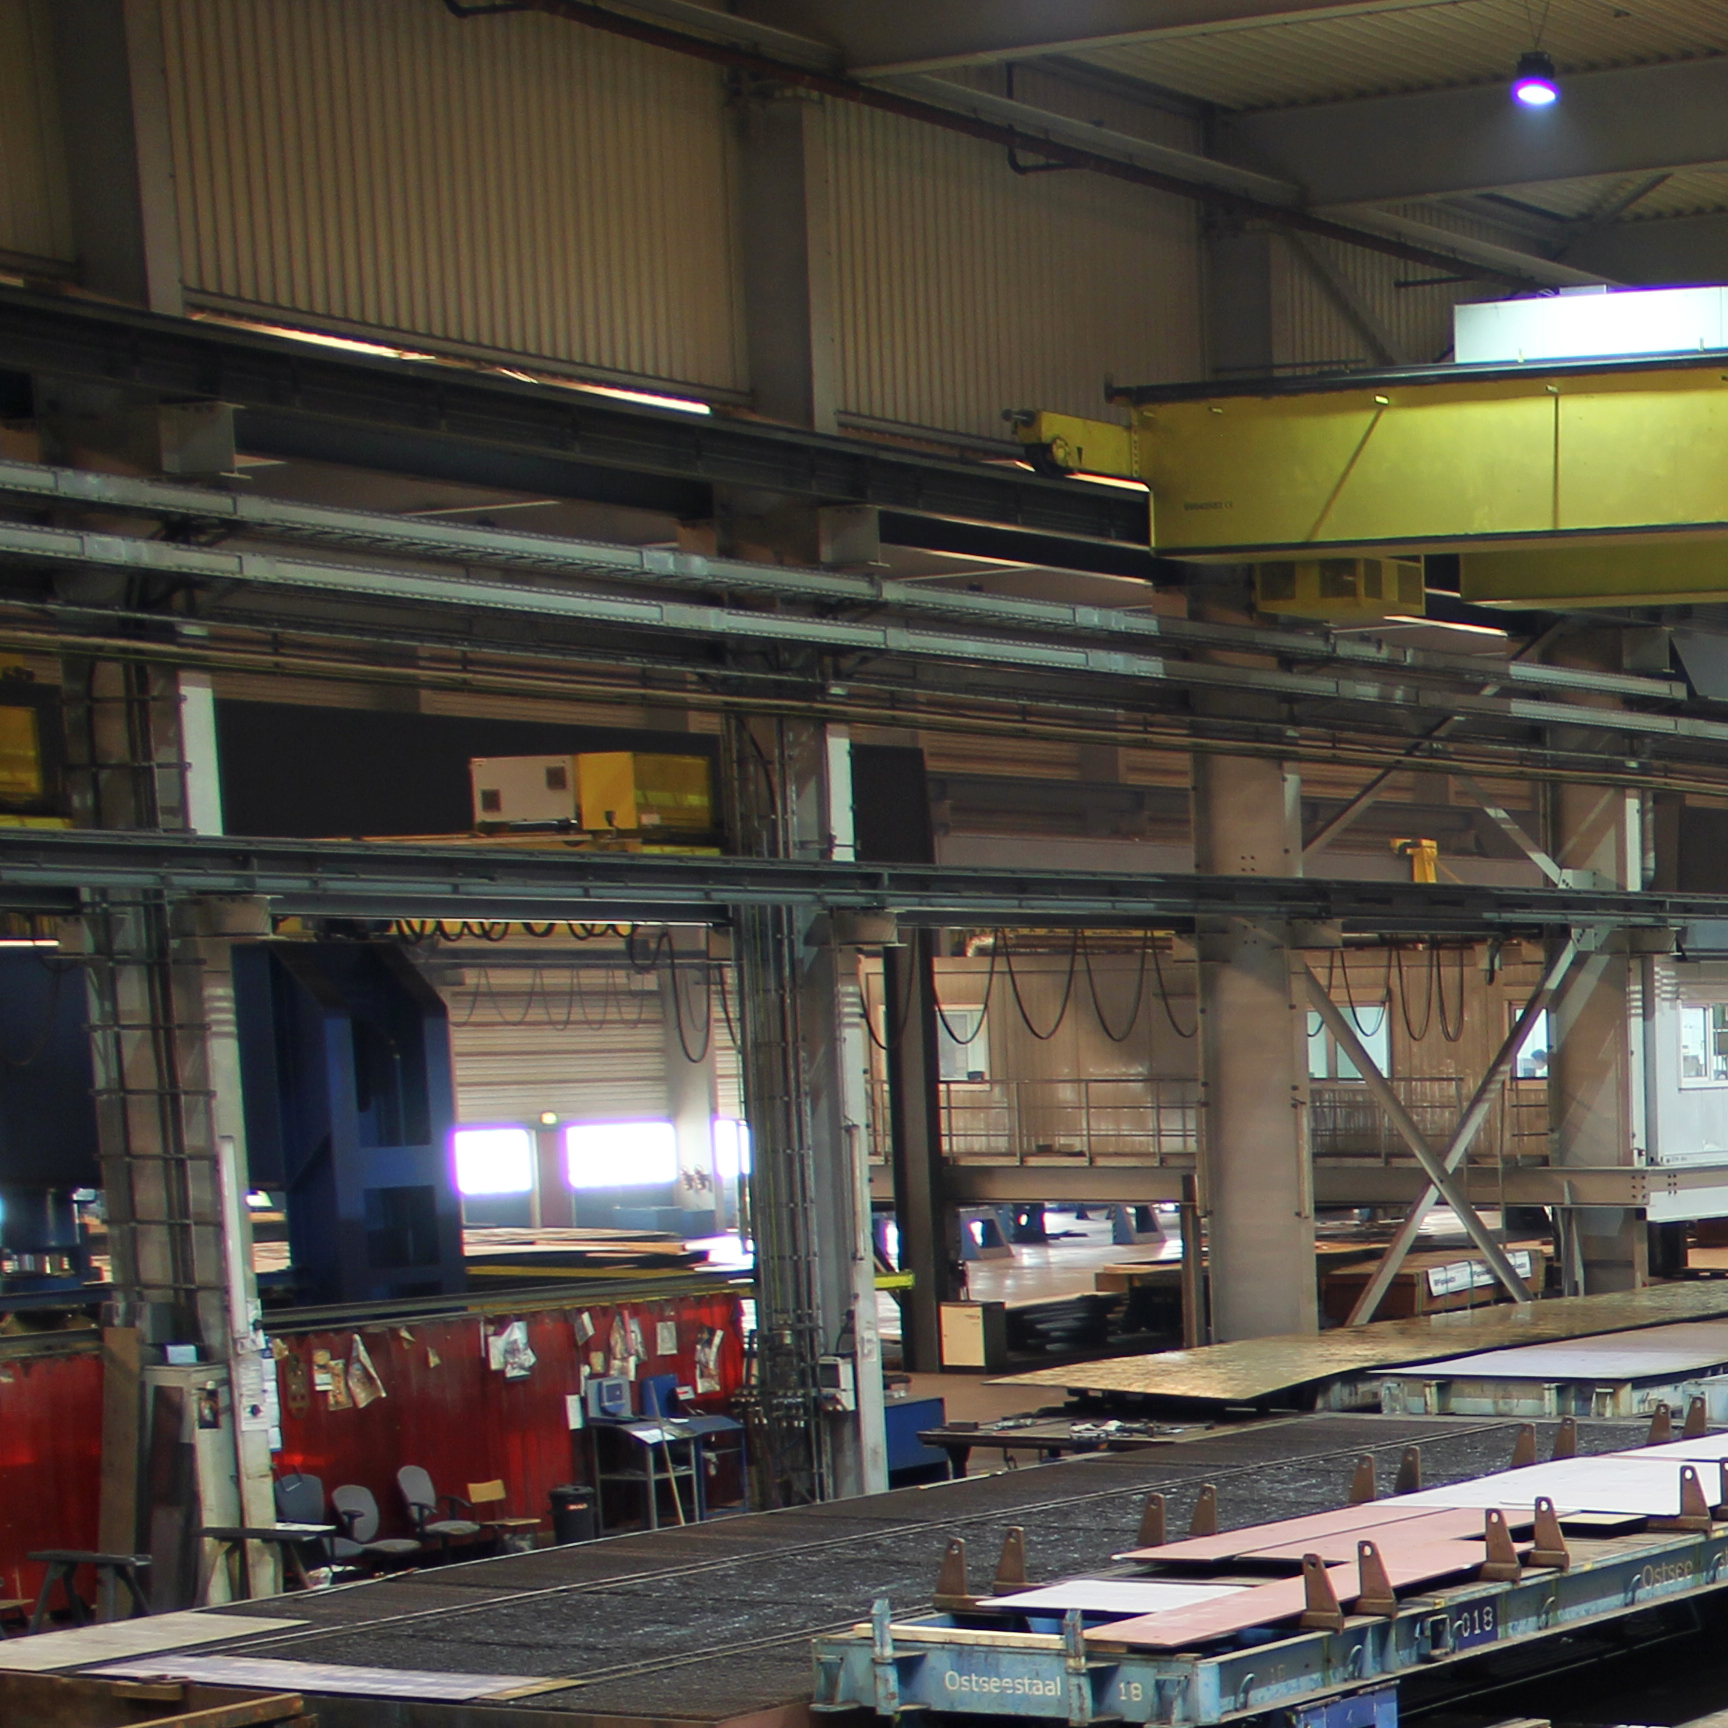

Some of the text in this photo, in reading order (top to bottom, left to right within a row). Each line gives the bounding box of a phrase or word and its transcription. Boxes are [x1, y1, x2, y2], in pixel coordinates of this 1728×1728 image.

[1461, 1606, 1494, 1638] 018
[944, 1670, 1143, 1702] Ostseestaal 18
